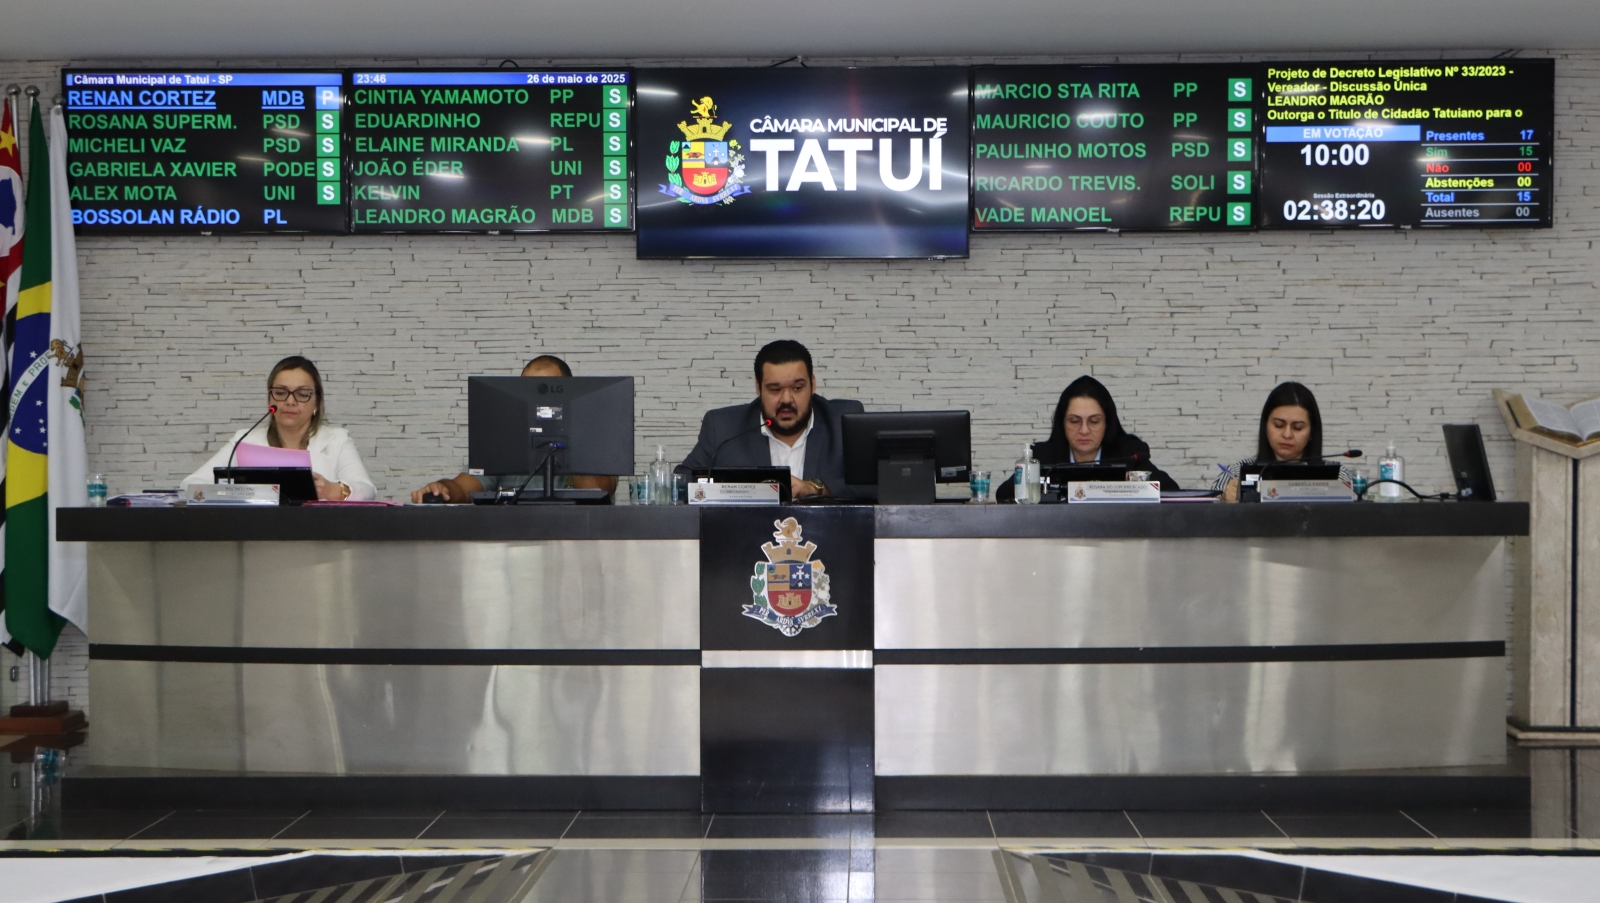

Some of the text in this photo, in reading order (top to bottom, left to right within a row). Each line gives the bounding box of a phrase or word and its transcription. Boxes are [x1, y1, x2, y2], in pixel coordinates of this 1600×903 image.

[74, 74, 114, 84] Câmara
[116, 74, 166, 86] Municipal
[169, 75, 182, 84] de
[218, 75, 233, 84] SP
[357, 74, 386, 84] 23:46
[527, 74, 626, 83] 26 de maio de 2025
[1268, 68, 1310, 81] Projeto
[1312, 68, 1327, 78] de
[1330, 68, 1375, 78] Decreto
[1378, 66, 1442, 80] Legislativo
[1445, 66, 1458, 77] Nº
[1461, 66, 1505, 77] 33/2023
[976, 82, 1246, 99] MARCIO STA RITA PP S
[1268, 82, 1320, 93] Vereador
[1330, 81, 1392, 92] Discussão
[1394, 77, 1427, 91] Única
[68, 90, 334, 106] RENAN CORTEZ MDB P
[354, 89, 621, 104] CINTIA YAMAMOTO PP S
[1268, 93, 1384, 106] LEANDRO MAGRÃO
[69, 114, 334, 129] ROSANA SUPERM. PSD S
[355, 113, 621, 128] EDUARDINHO REPU S
[976, 112, 1246, 129] MAURICIO COUTO PP S
[1267, 110, 1314, 122] Outorga
[1364, 109, 1378, 119] de
[1381, 108, 1429, 119] Cidadão
[1433, 107, 1483, 118] Tatuiano
[1486, 110, 1512, 120] para
[1515, 109, 1522, 118] o
[750, 115, 947, 132] CÂMARA MUNICIPAL DE
[1303, 126, 1383, 140] EM VOTAÇÃO
[1426, 130, 1534, 141] Presentes 17
[69, 138, 334, 153] MICHELI VAZ PSD S
[355, 137, 621, 152] ELAINE MIRANDA PL S
[976, 142, 1246, 158] PAULINHO MOTOS PSD S
[1426, 146, 1532, 157] Sim 15
[750, 131, 946, 192] TATUÍ
[1301, 144, 1369, 166] 10:00
[70, 162, 335, 177] GABRIELA XAVIER PODE S
[354, 158, 621, 176] JOÃO ÉDER UNI S
[1426, 162, 1532, 173] Não 00
[976, 175, 1246, 191] RICARDO TREVIS. SOLI S
[1426, 177, 1532, 190] Abstenções 00
[70, 186, 335, 200] ALEX MOTA UNI S
[354, 184, 621, 200] KELVIN PT S
[1426, 192, 1531, 202] Total 15
[71, 206, 287, 224] BOSSOLAN RÁDIO PL
[355, 206, 621, 224] LEANDRO MAGRÃO MDB S
[976, 206, 1245, 222] VADE MANOEL REPU S
[1283, 199, 1385, 221] 02:38:20
[1425, 207, 1530, 218] Ausentes 00
[550, 385, 563, 393] LG
